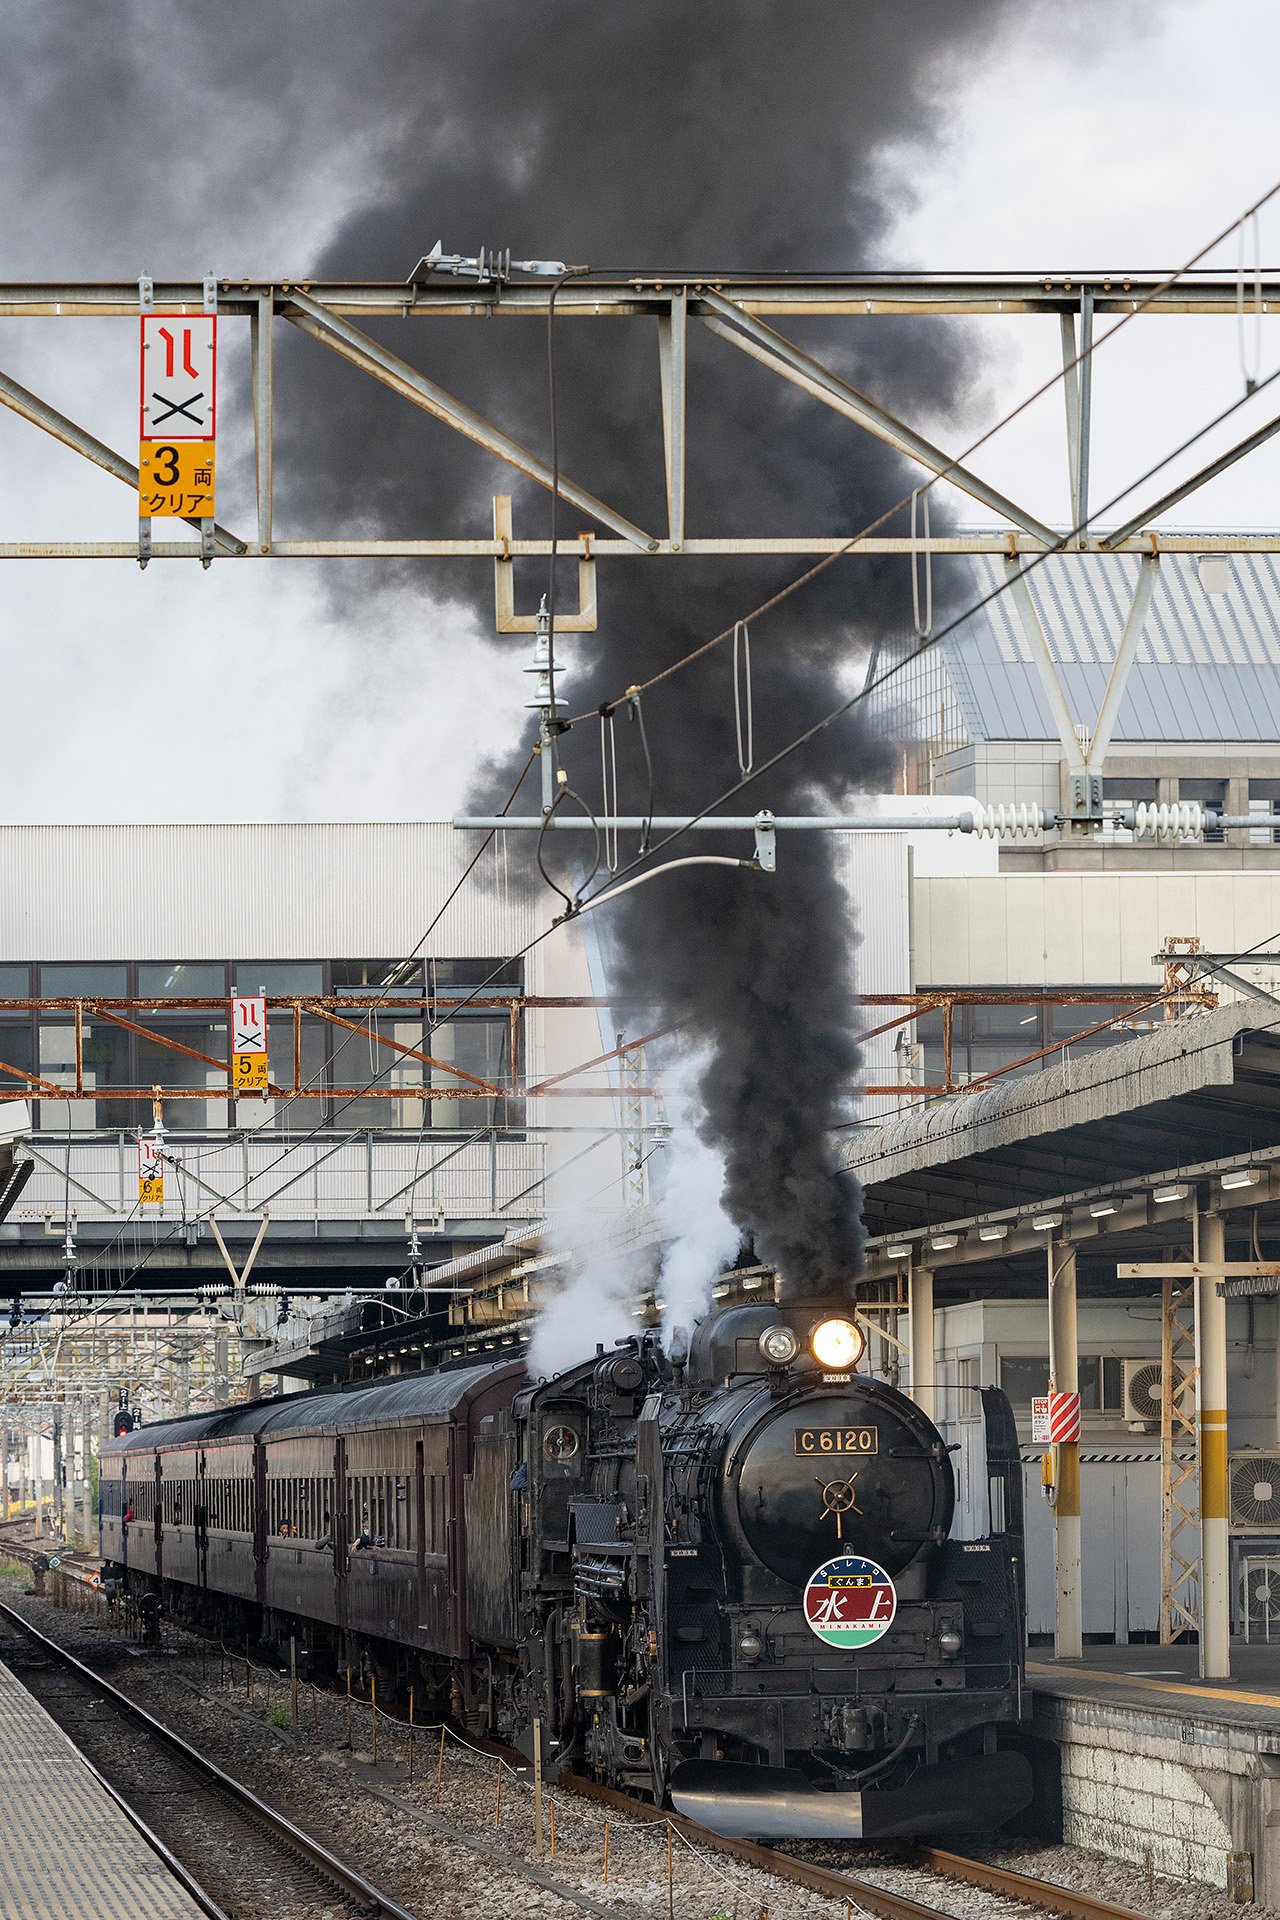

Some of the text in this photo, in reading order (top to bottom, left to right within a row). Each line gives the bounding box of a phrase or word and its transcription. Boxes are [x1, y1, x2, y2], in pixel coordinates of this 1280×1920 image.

[149, 493, 205, 513] クリア
[237, 1077, 263, 1087] クリア
[801, 1430, 872, 1451] C6120
[836, 1578, 865, 1586] ぐんま
[809, 1590, 892, 1623] 水上
[819, 1622, 881, 1630] MINAKAMI
